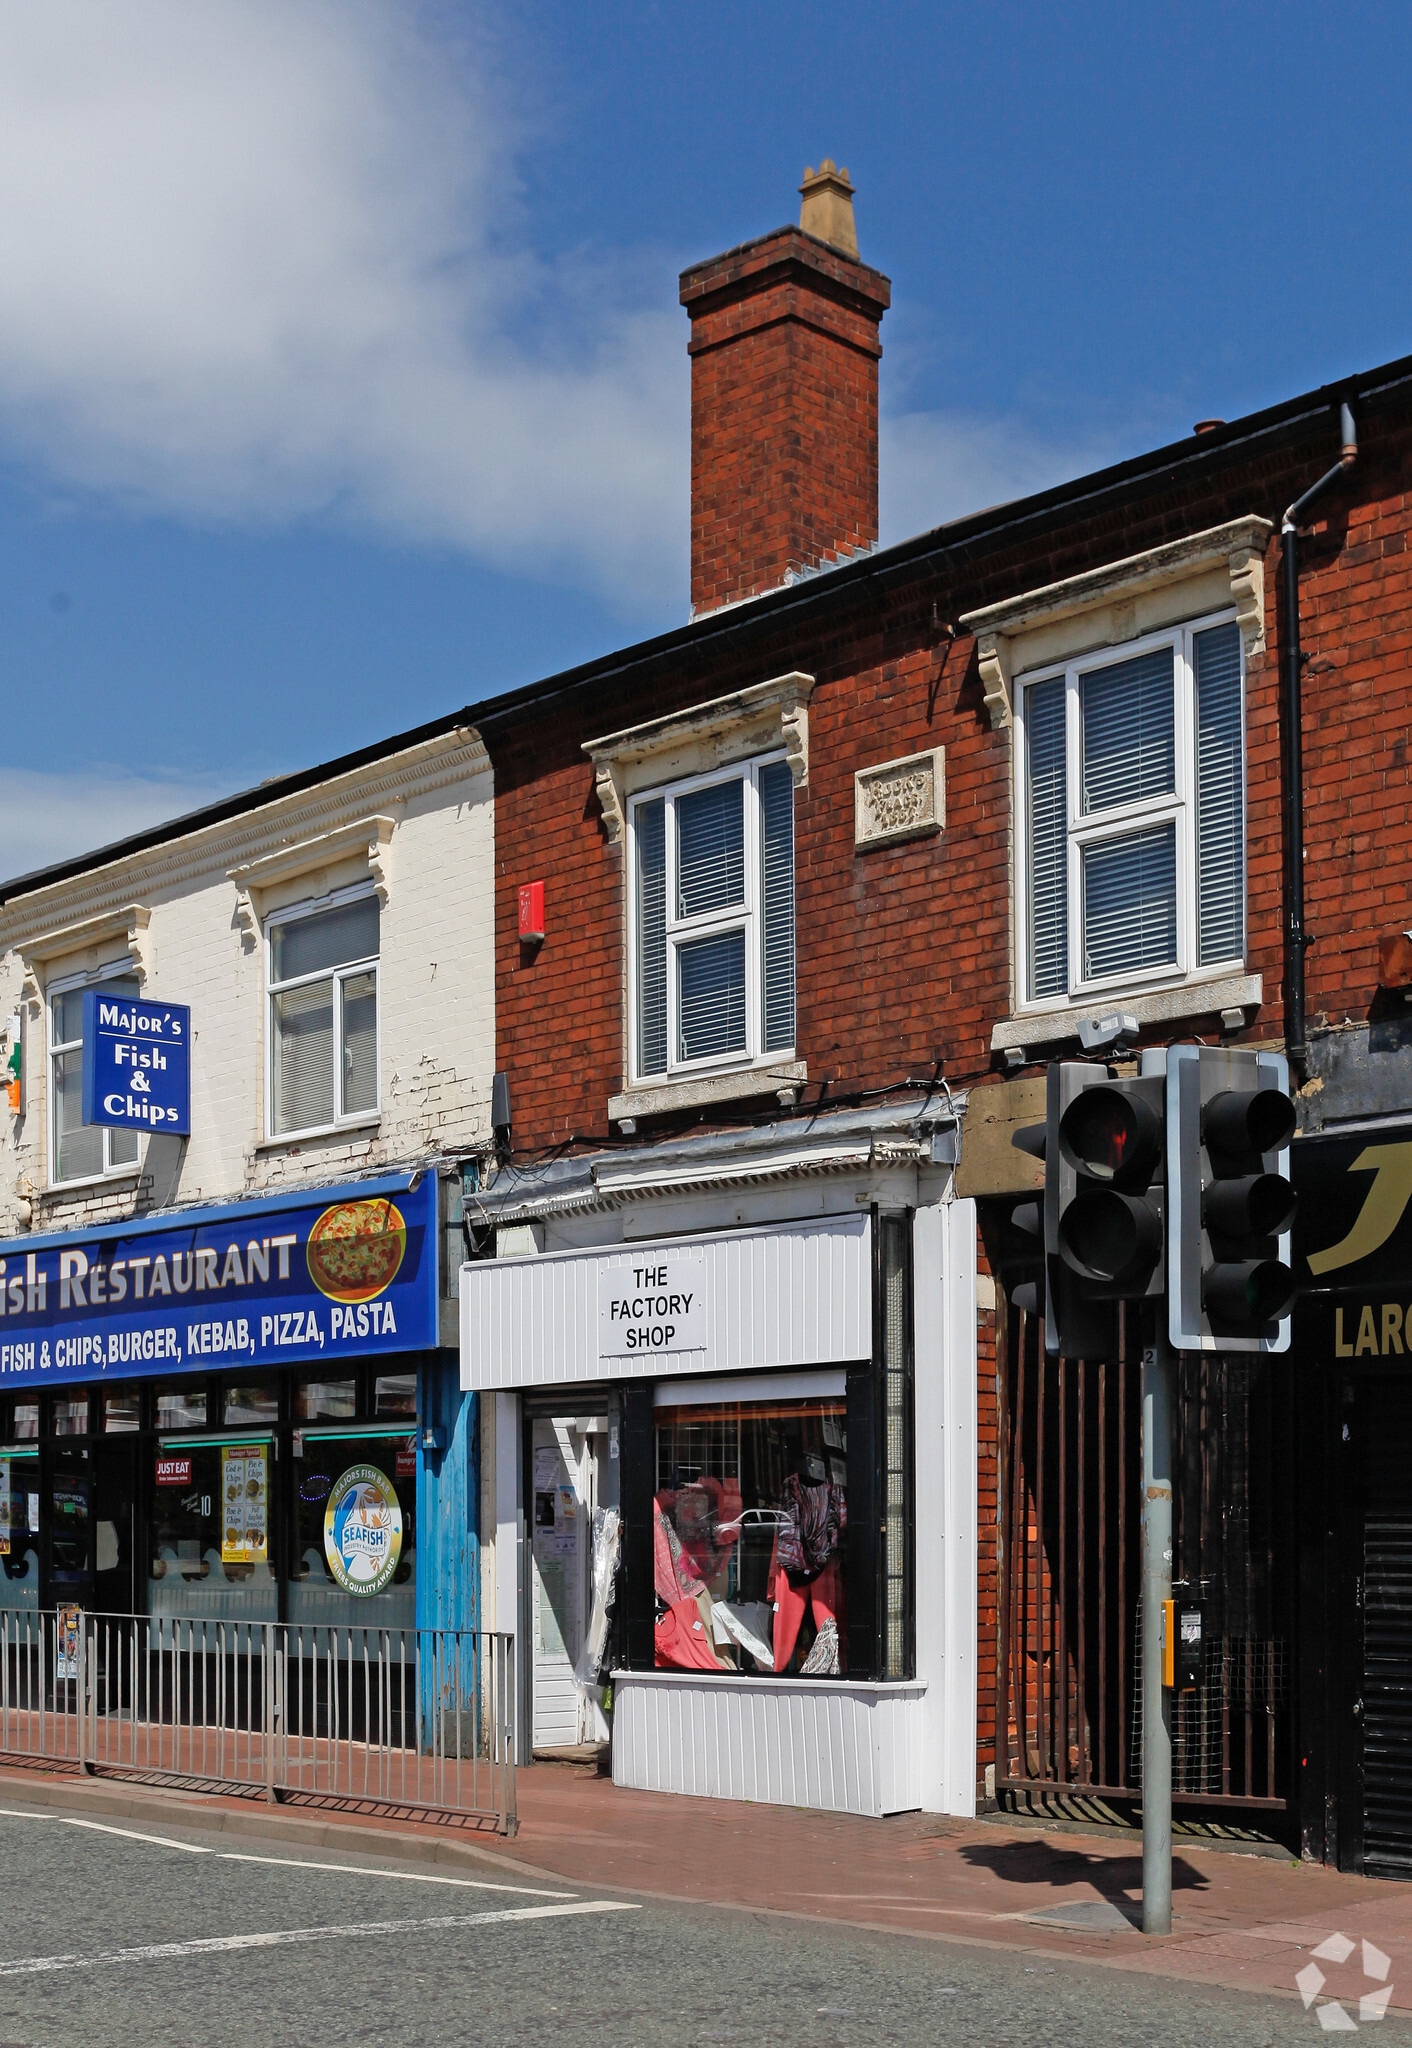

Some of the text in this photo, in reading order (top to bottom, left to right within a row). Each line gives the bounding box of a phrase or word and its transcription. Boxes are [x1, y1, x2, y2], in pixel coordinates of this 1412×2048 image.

[114, 1043, 167, 1071] Fish
[129, 1070, 152, 1093] &
[103, 1093, 179, 1126] Chips
[59, 1233, 297, 1310] RESTAURANT
[632, 1265, 668, 1289] THE
[610, 1293, 694, 1321] FACTORY
[1, 1342, 35, 1373] FISH
[40, 1340, 52, 1369] &
[187, 1318, 255, 1356] KEBAB,
[261, 1310, 325, 1349] PIZZA,
[331, 1301, 397, 1340] PASTA
[626, 1325, 676, 1349] SHOP
[1145, 1350, 1154, 1364] 2
[157, 1461, 190, 1475] JUST EAT
[334, 1469, 390, 1499] MAJORS FISH BAR
[343, 1526, 383, 1546] SEAFISH
[348, 1581, 377, 1594] QUALITY
[376, 1557, 396, 1588] AWARD
